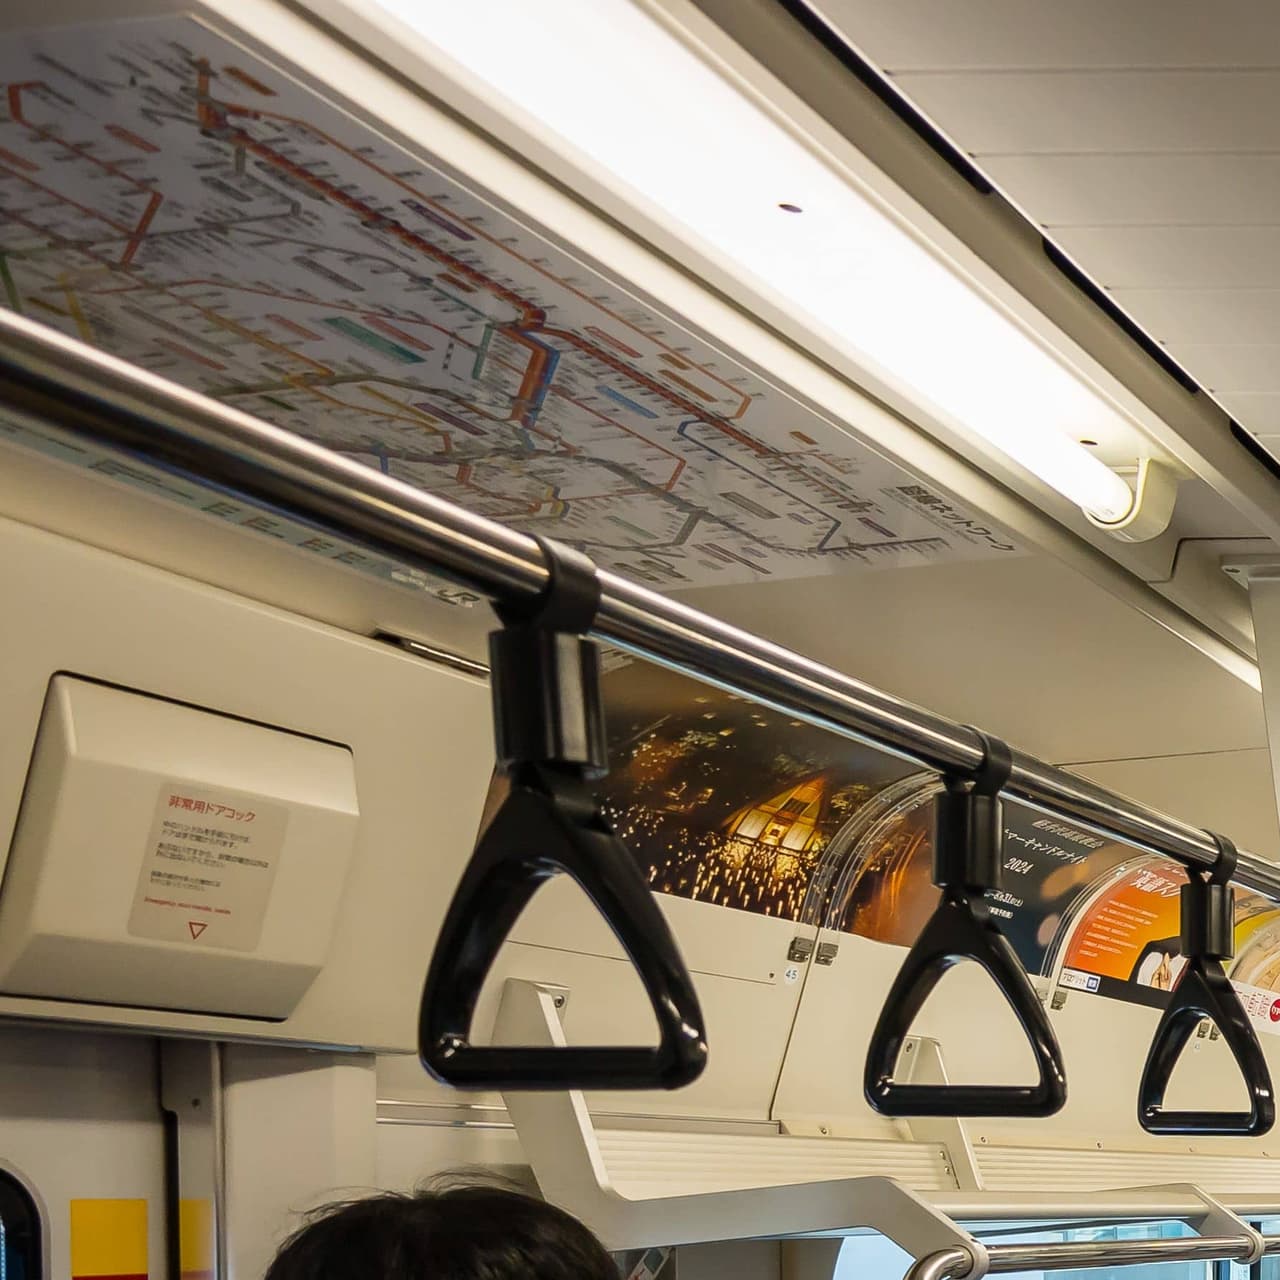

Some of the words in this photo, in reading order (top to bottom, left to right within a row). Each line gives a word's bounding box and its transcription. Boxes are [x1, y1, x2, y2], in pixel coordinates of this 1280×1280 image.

[168, 794, 256, 823] 非常用ドアコック
[1004, 828, 1088, 865] マーキャンドルナイト
[1003, 857, 1034, 875] 2024
[785, 970, 798, 980] 45
